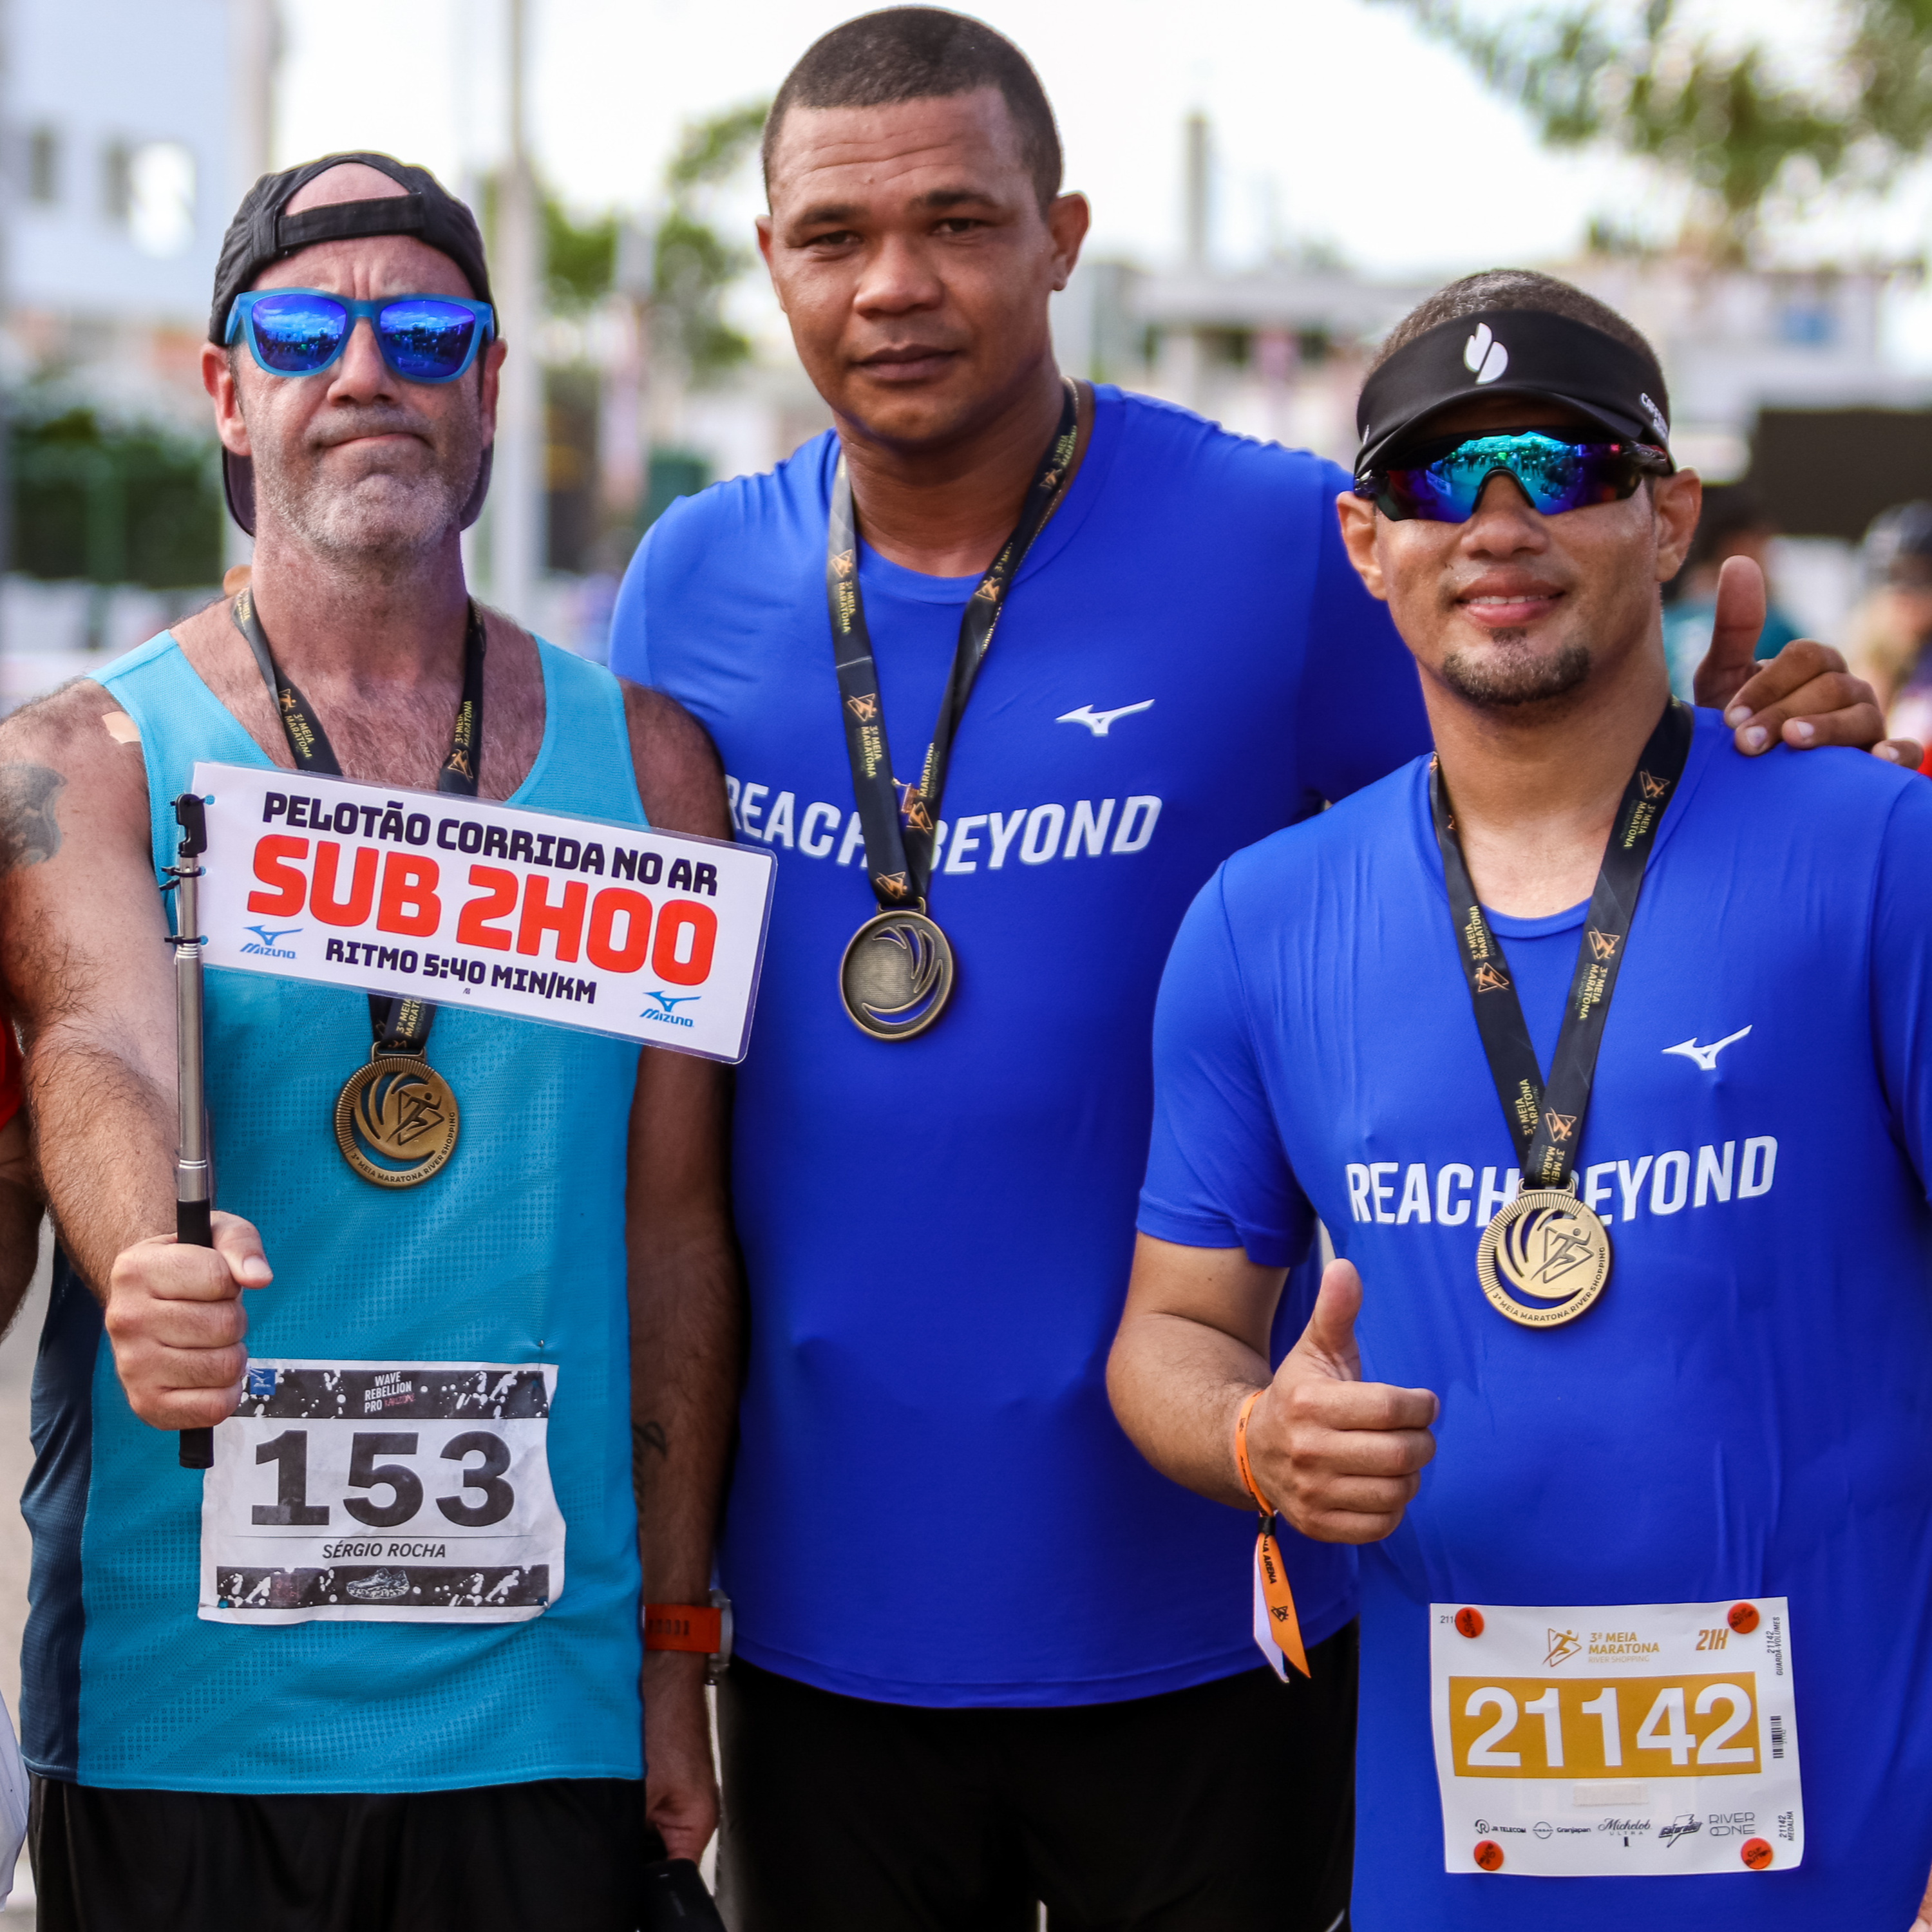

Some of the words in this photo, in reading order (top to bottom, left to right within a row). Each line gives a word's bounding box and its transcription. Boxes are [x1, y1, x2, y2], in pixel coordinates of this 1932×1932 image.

[838, 582, 851, 633] MARATONA
[847, 591, 856, 615] MEIA
[284, 715, 312, 758] MARATONA
[298, 722, 315, 743] MEIA
[464, 702, 472, 748] MARATONA
[861, 726, 877, 777] MARATONA
[871, 737, 882, 761] MEIA
[920, 743, 934, 797] MARATONA
[1623, 800, 1647, 848] MARATONA
[1638, 813, 1653, 834] MEIA
[262, 791, 431, 846] PELOTÃO
[436, 818, 605, 875] CORRIDA
[611, 846, 663, 886] NO
[667, 858, 717, 896] AR
[247, 833, 442, 938] SUB
[456, 864, 718, 986] 2H00
[1464, 923, 1479, 948] MEIA
[1469, 905, 1490, 958] MARATONA
[325, 938, 419, 974] RITMO
[422, 953, 486, 985] 5:40
[491, 964, 598, 1004] MIN/KM
[1579, 963, 1600, 1019] MARATONA
[1591, 978, 1605, 1003] MEIA
[404, 998, 422, 1037] MARATO
[1515, 1097, 1530, 1123] MEIA
[1519, 1078, 1539, 1130] ARATONA
[357, 1160, 376, 1177] MEIA
[377, 1171, 424, 1183] MARATONA
[423, 1154, 444, 1175] RIVER
[441, 1112, 456, 1155] SHOPPING
[1541, 1145, 1556, 1184] MARAT
[1345, 1160, 1520, 1228] REACH
[1570, 1135, 1779, 1227] EYOND
[1499, 1300, 1519, 1316] MEIA
[1520, 1309, 1570, 1321] MARATONA
[1570, 1291, 1593, 1313] RIVER
[1590, 1246, 1605, 1292] SHOPPING
[365, 1380, 412, 1401] REBELLION
[374, 1371, 401, 1387] WAVE
[365, 1399, 383, 1414] PRO
[251, 1429, 515, 1528] 153
[321, 1540, 383, 1559] SÉRGIO
[387, 1543, 446, 1559] ROCHA
[1262, 1554, 1277, 1584] ARENA
[1588, 1642, 1660, 1654] MARATONA
[1605, 1631, 1637, 1643] MEIA
[1766, 1630, 1776, 1654] 21142
[1772, 1616, 1784, 1676] GUARDA-VOLUMES
[1611, 1654, 1650, 1663] SHOPPING
[1464, 1681, 1755, 1767] 21142
[1598, 1817, 1651, 1831] Michelob
[1709, 1812, 1756, 1824] RIVER
[1710, 1824, 1756, 1836] ONE
[1777, 1814, 1788, 1838] 21142
[1786, 1810, 1795, 1841] MEDALHA
